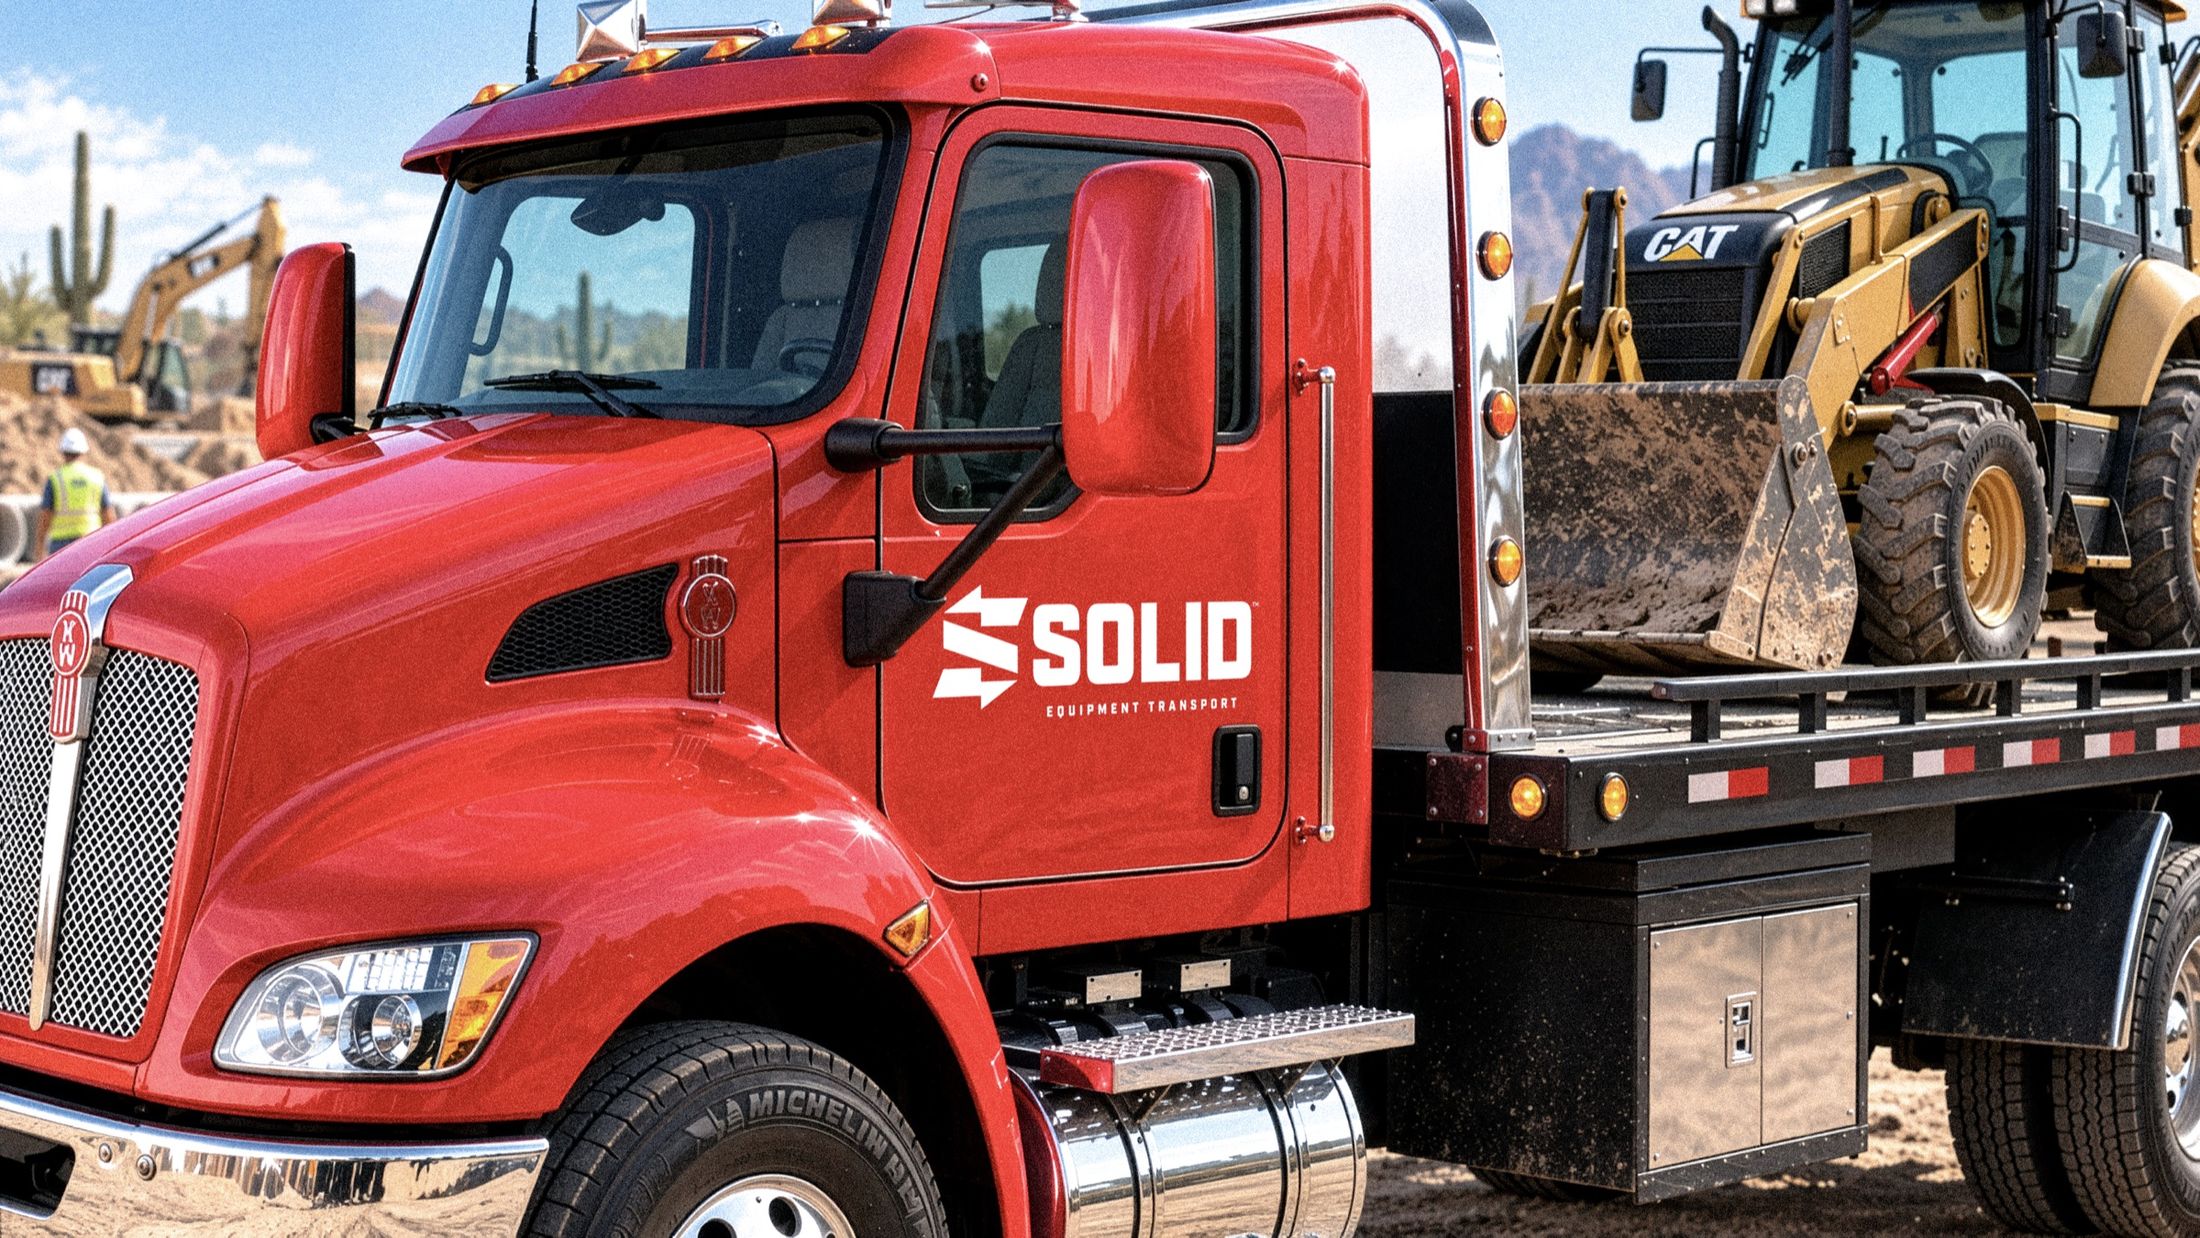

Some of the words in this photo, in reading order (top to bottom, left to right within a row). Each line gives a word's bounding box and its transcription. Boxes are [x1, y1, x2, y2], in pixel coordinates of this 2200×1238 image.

[1644, 225, 1740, 262] CAT
[1033, 601, 1252, 687] SOLID
[1046, 702, 1140, 719] EQUIPMENT
[1148, 697, 1238, 713] TRANSPORT
[748, 1089, 891, 1161] MICHELIN
